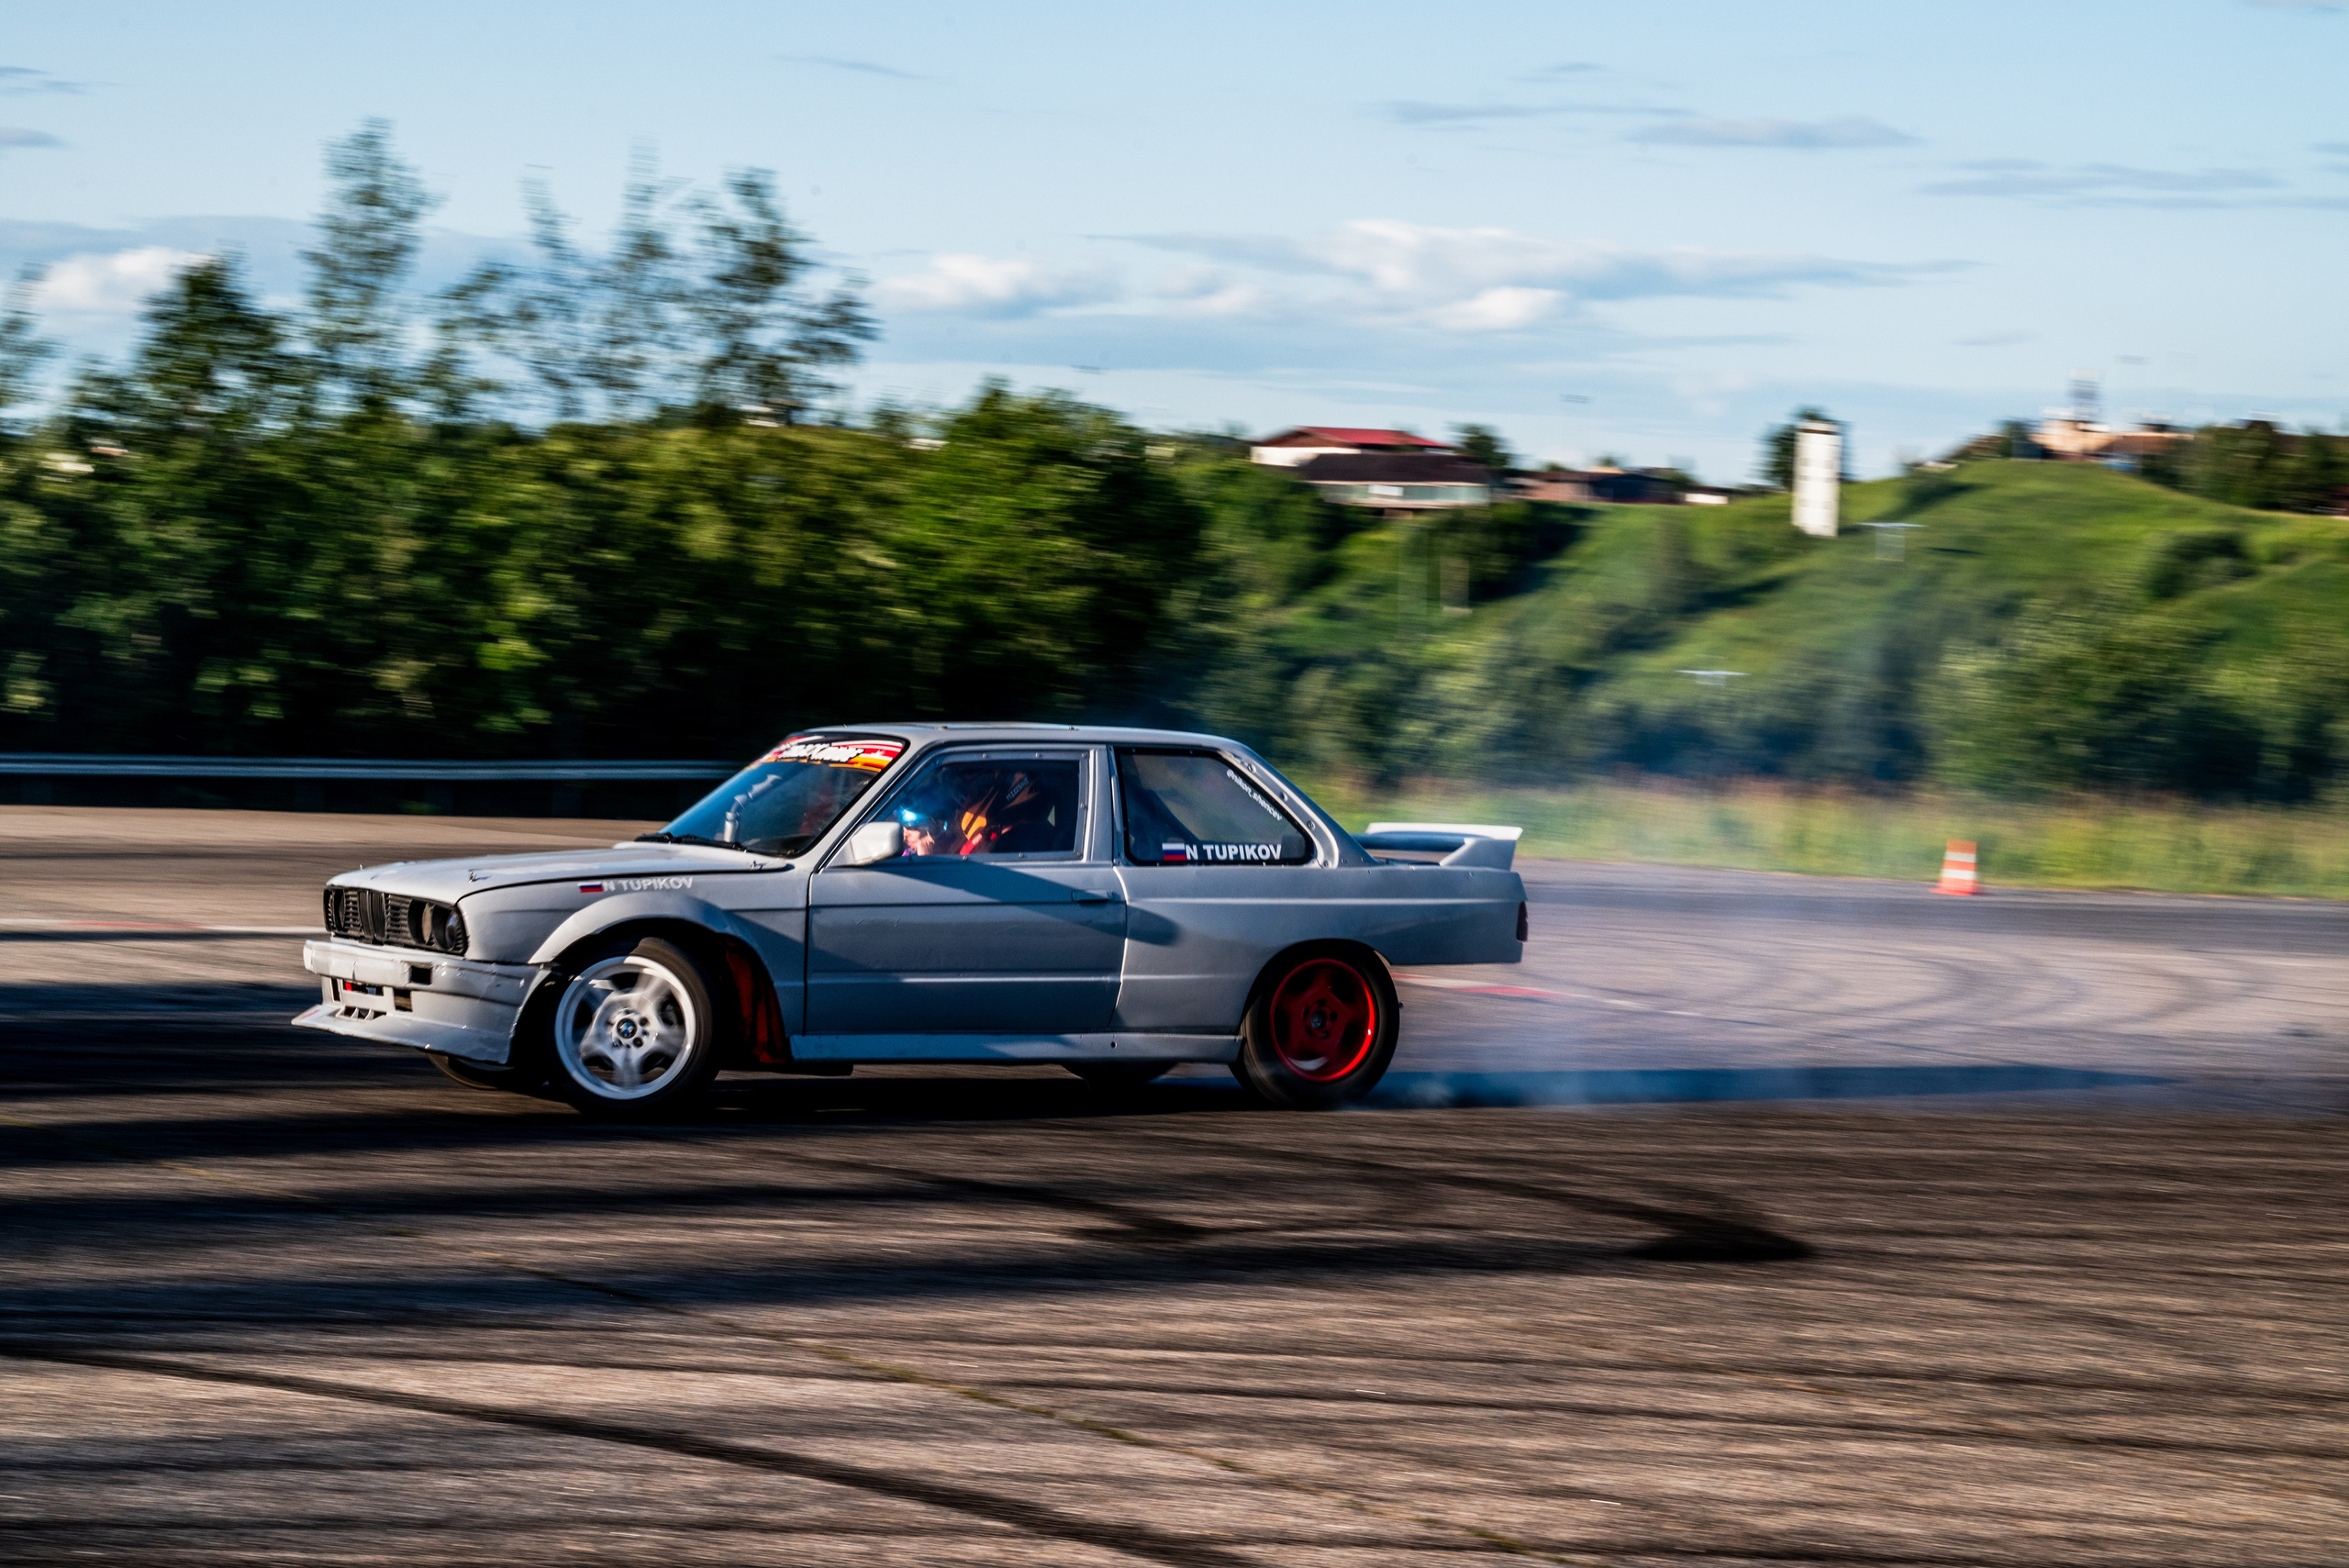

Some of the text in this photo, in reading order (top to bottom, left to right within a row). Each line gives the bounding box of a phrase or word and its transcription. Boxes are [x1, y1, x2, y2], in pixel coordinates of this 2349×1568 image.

[1186, 844, 1282, 861] N TUPIKOV
[603, 876, 694, 892] N TUPIKOV
